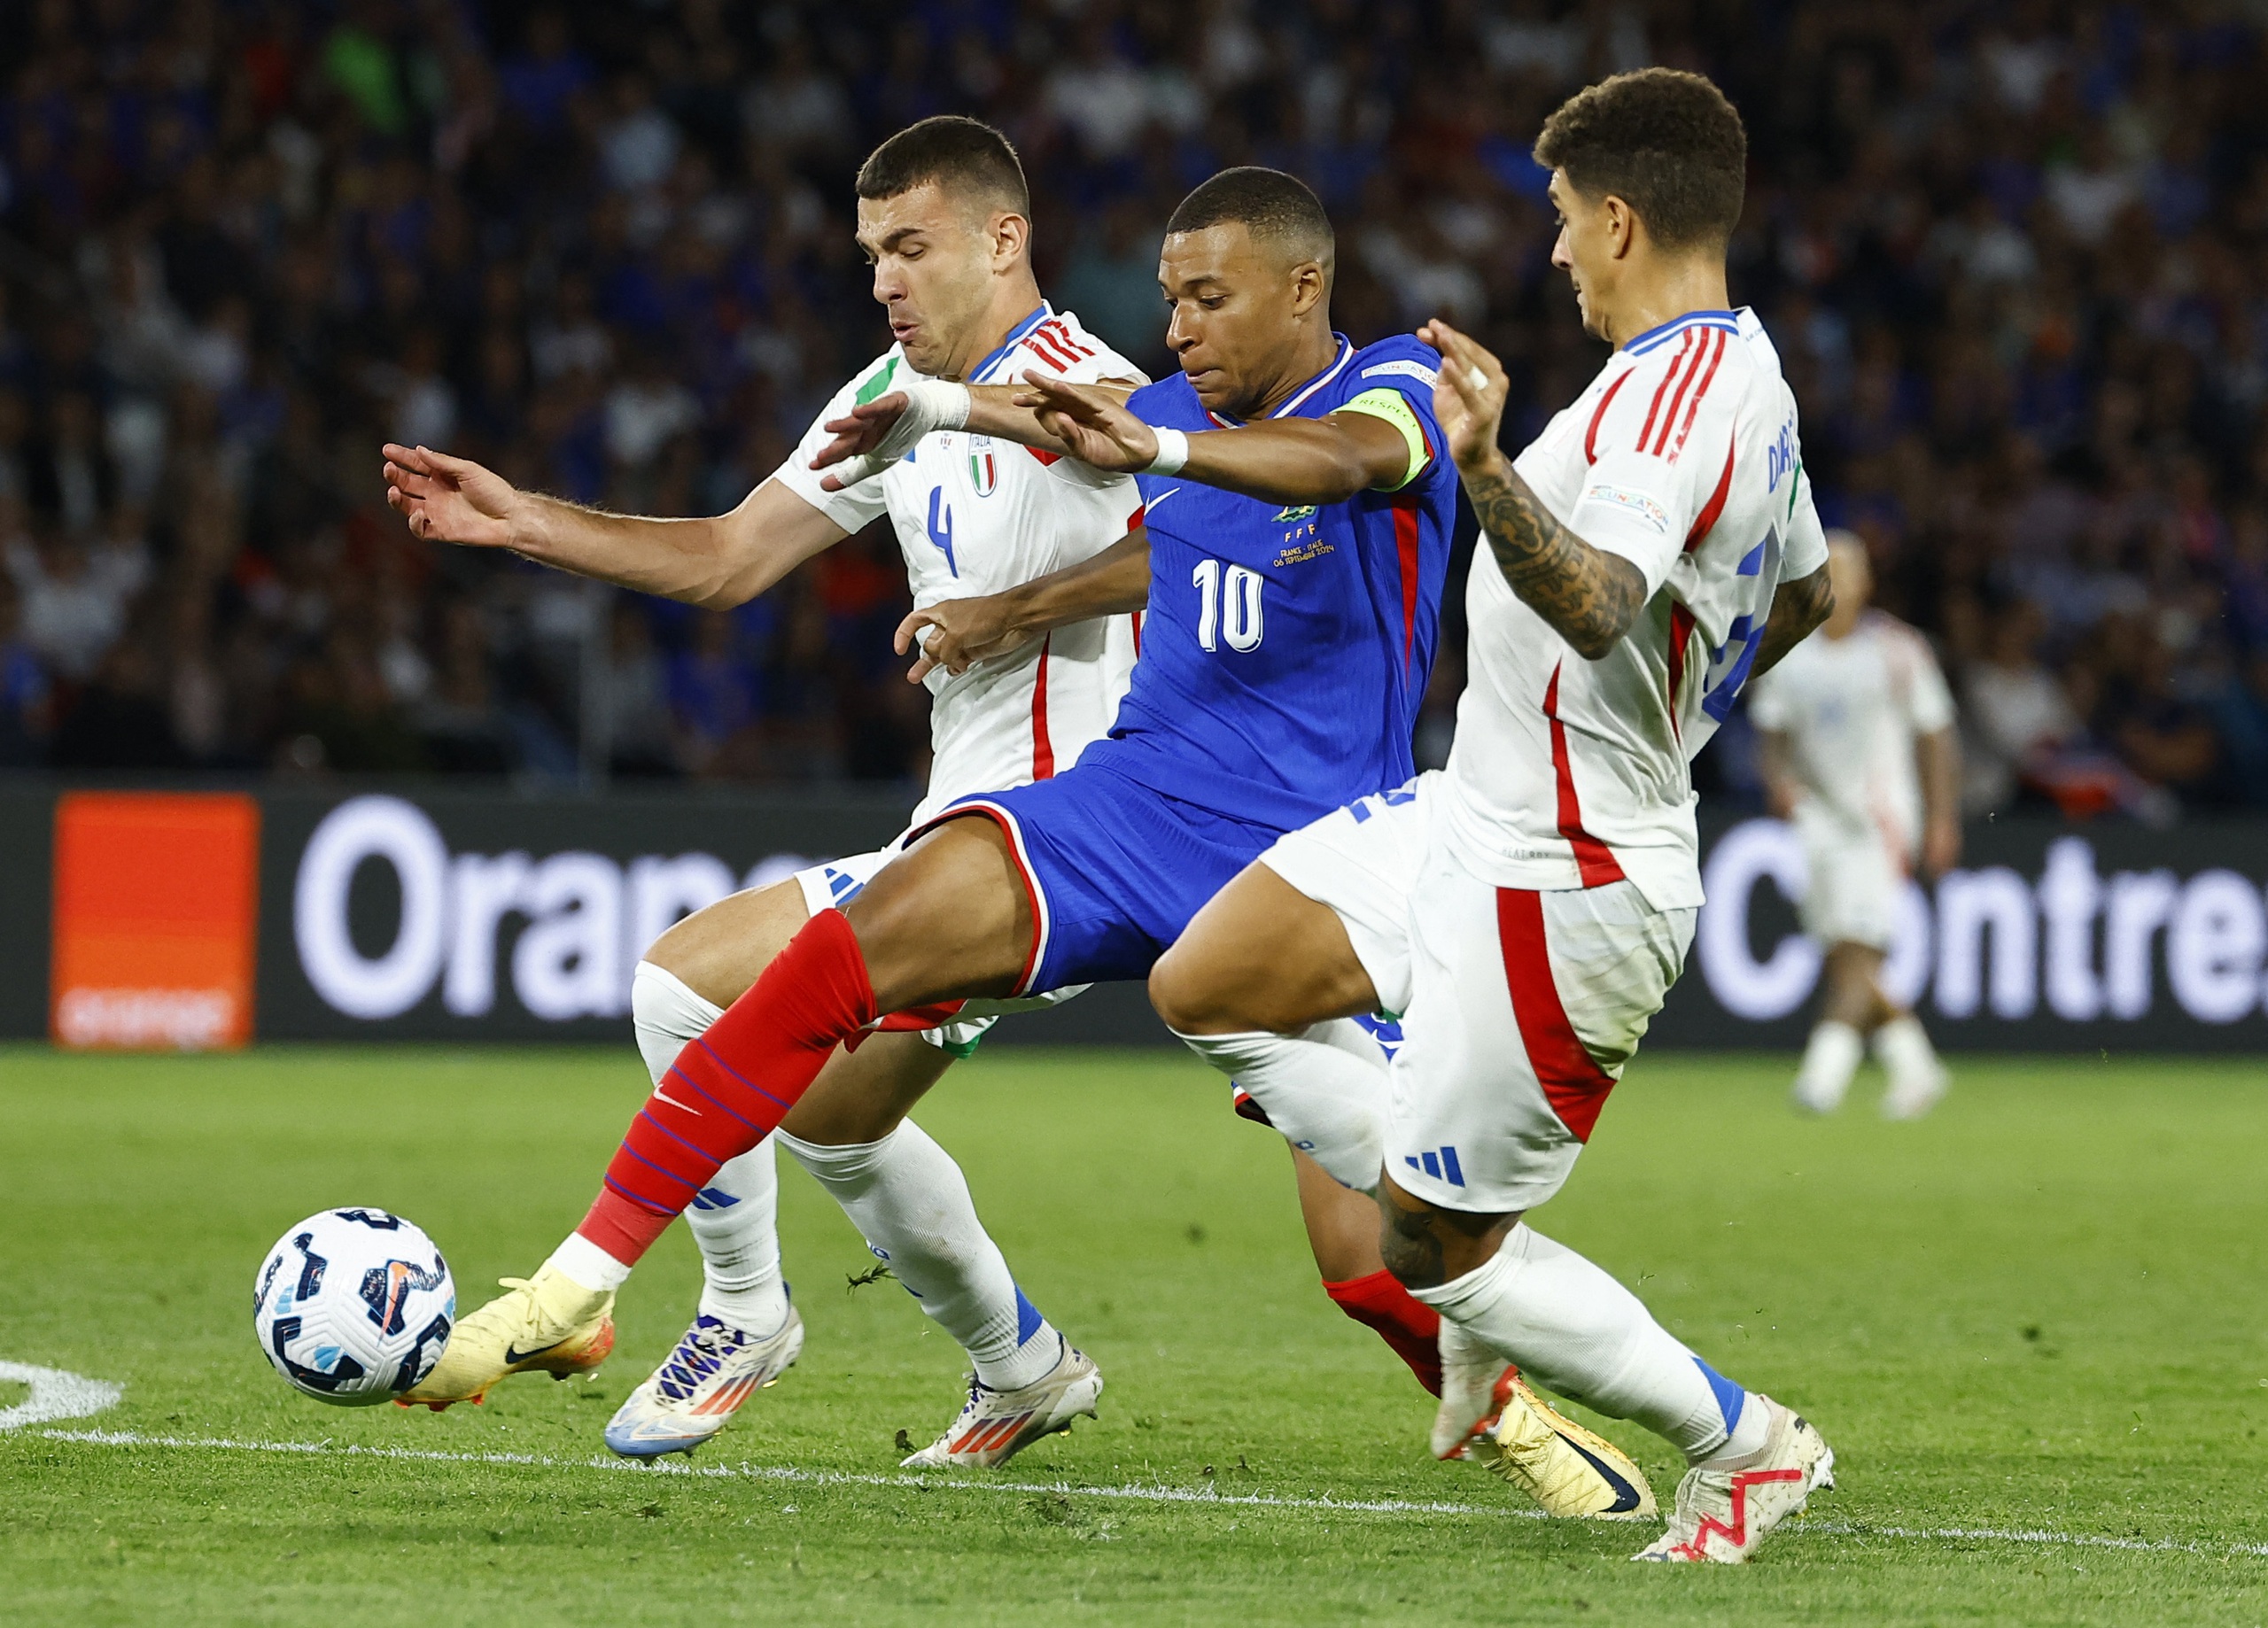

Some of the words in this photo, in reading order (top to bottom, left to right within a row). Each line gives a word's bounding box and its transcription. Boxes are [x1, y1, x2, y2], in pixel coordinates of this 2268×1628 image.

[971, 435, 991, 448] ITALIA
[928, 485, 959, 579] 4
[1280, 547, 1301, 558] FRANCE
[1307, 539, 1324, 551] ITALIE
[1316, 545, 1335, 555] 2024
[1192, 559, 1263, 653] 10
[293, 795, 824, 1019] Oran
[1698, 819, 2268, 1023] Cntre
